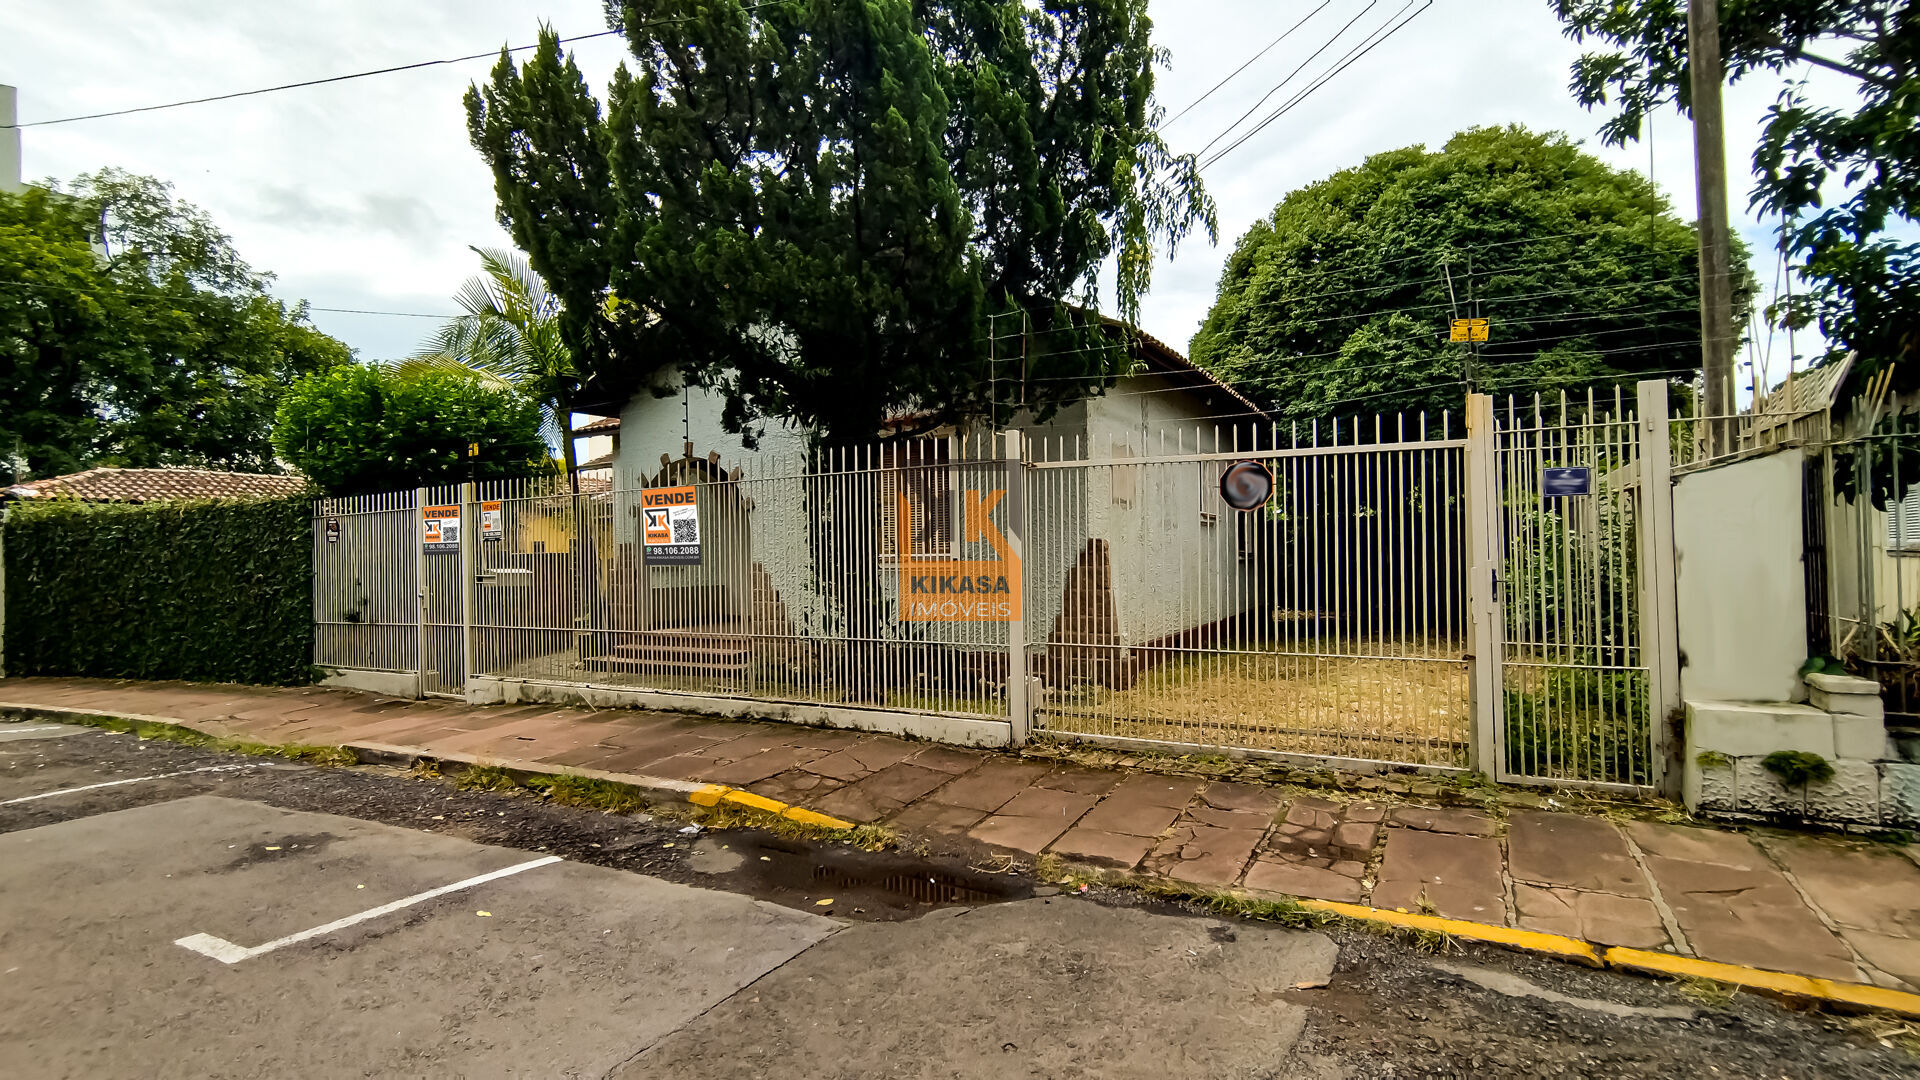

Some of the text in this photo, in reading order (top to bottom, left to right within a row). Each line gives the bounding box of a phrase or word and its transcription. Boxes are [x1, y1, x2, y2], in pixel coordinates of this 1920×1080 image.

[644, 492, 694, 505] VENDE
[425, 509, 458, 518] VENDE
[653, 546, 699, 555] 98.106.2088
